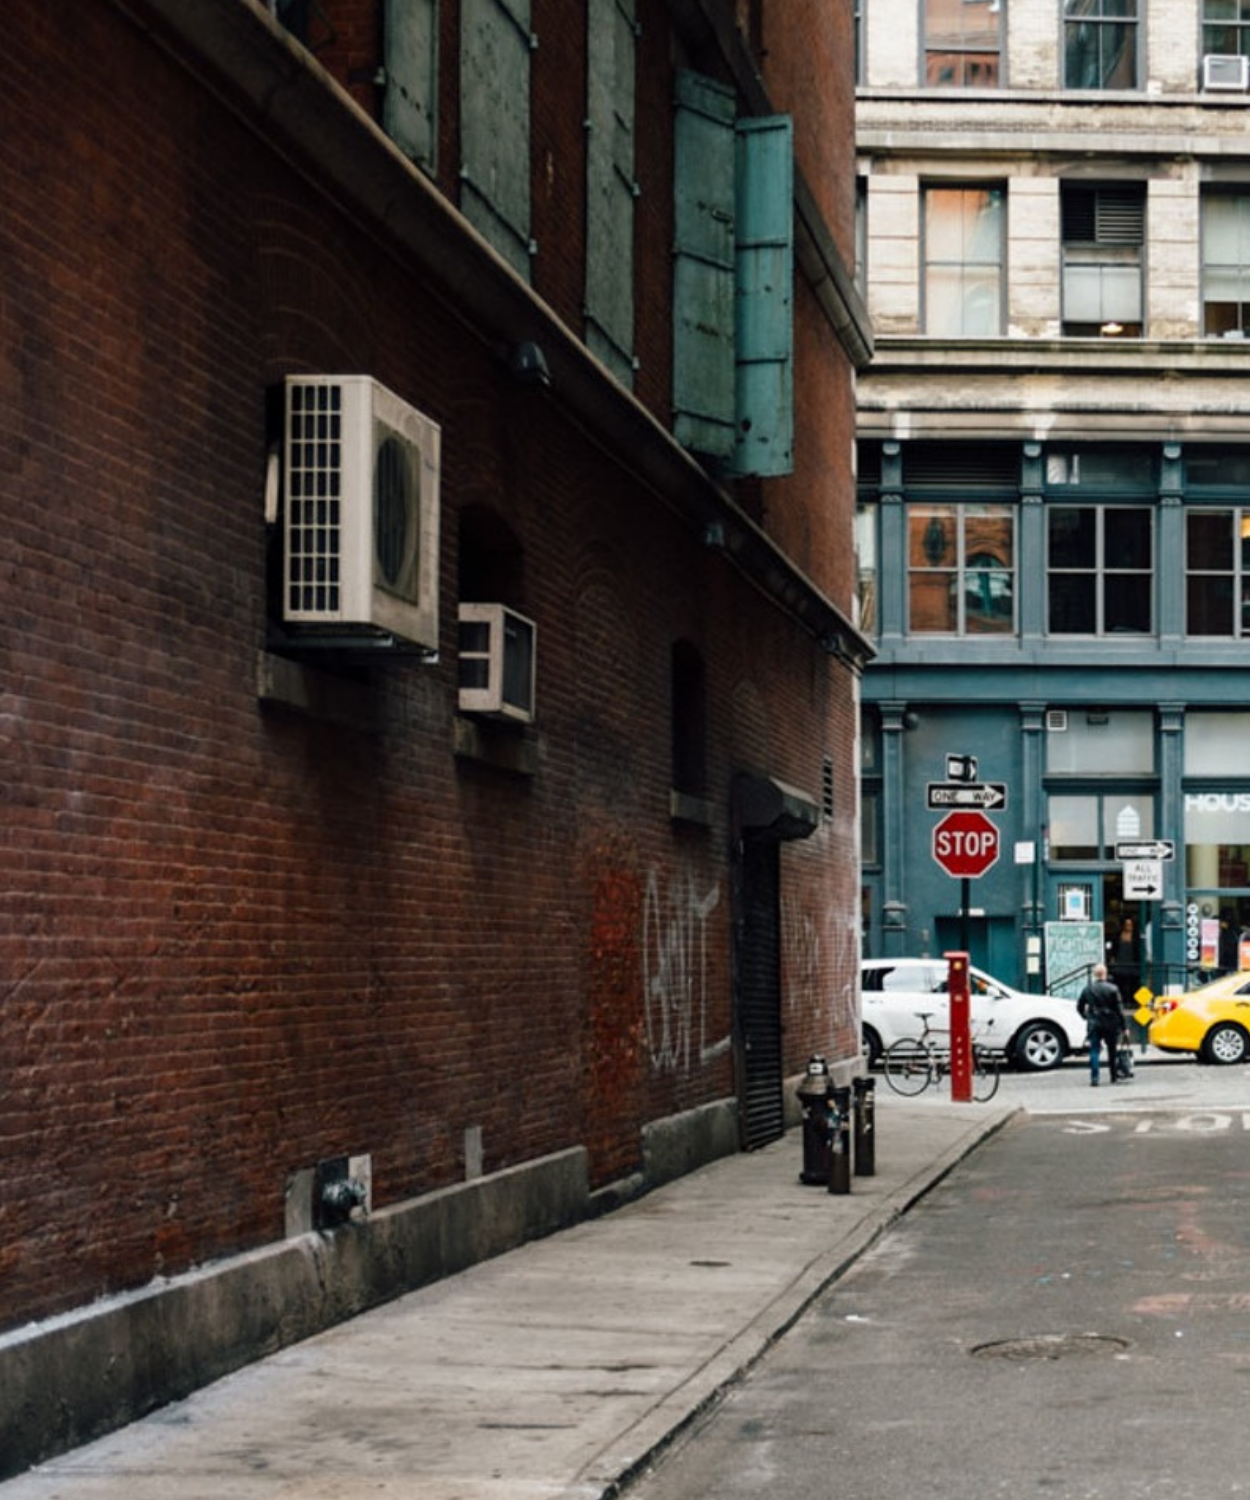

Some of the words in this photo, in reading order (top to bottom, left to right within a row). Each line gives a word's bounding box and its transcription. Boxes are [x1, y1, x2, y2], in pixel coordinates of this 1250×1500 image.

[934, 791, 957, 801] ONE
[973, 791, 997, 801] WAY
[937, 831, 995, 856] STOP
